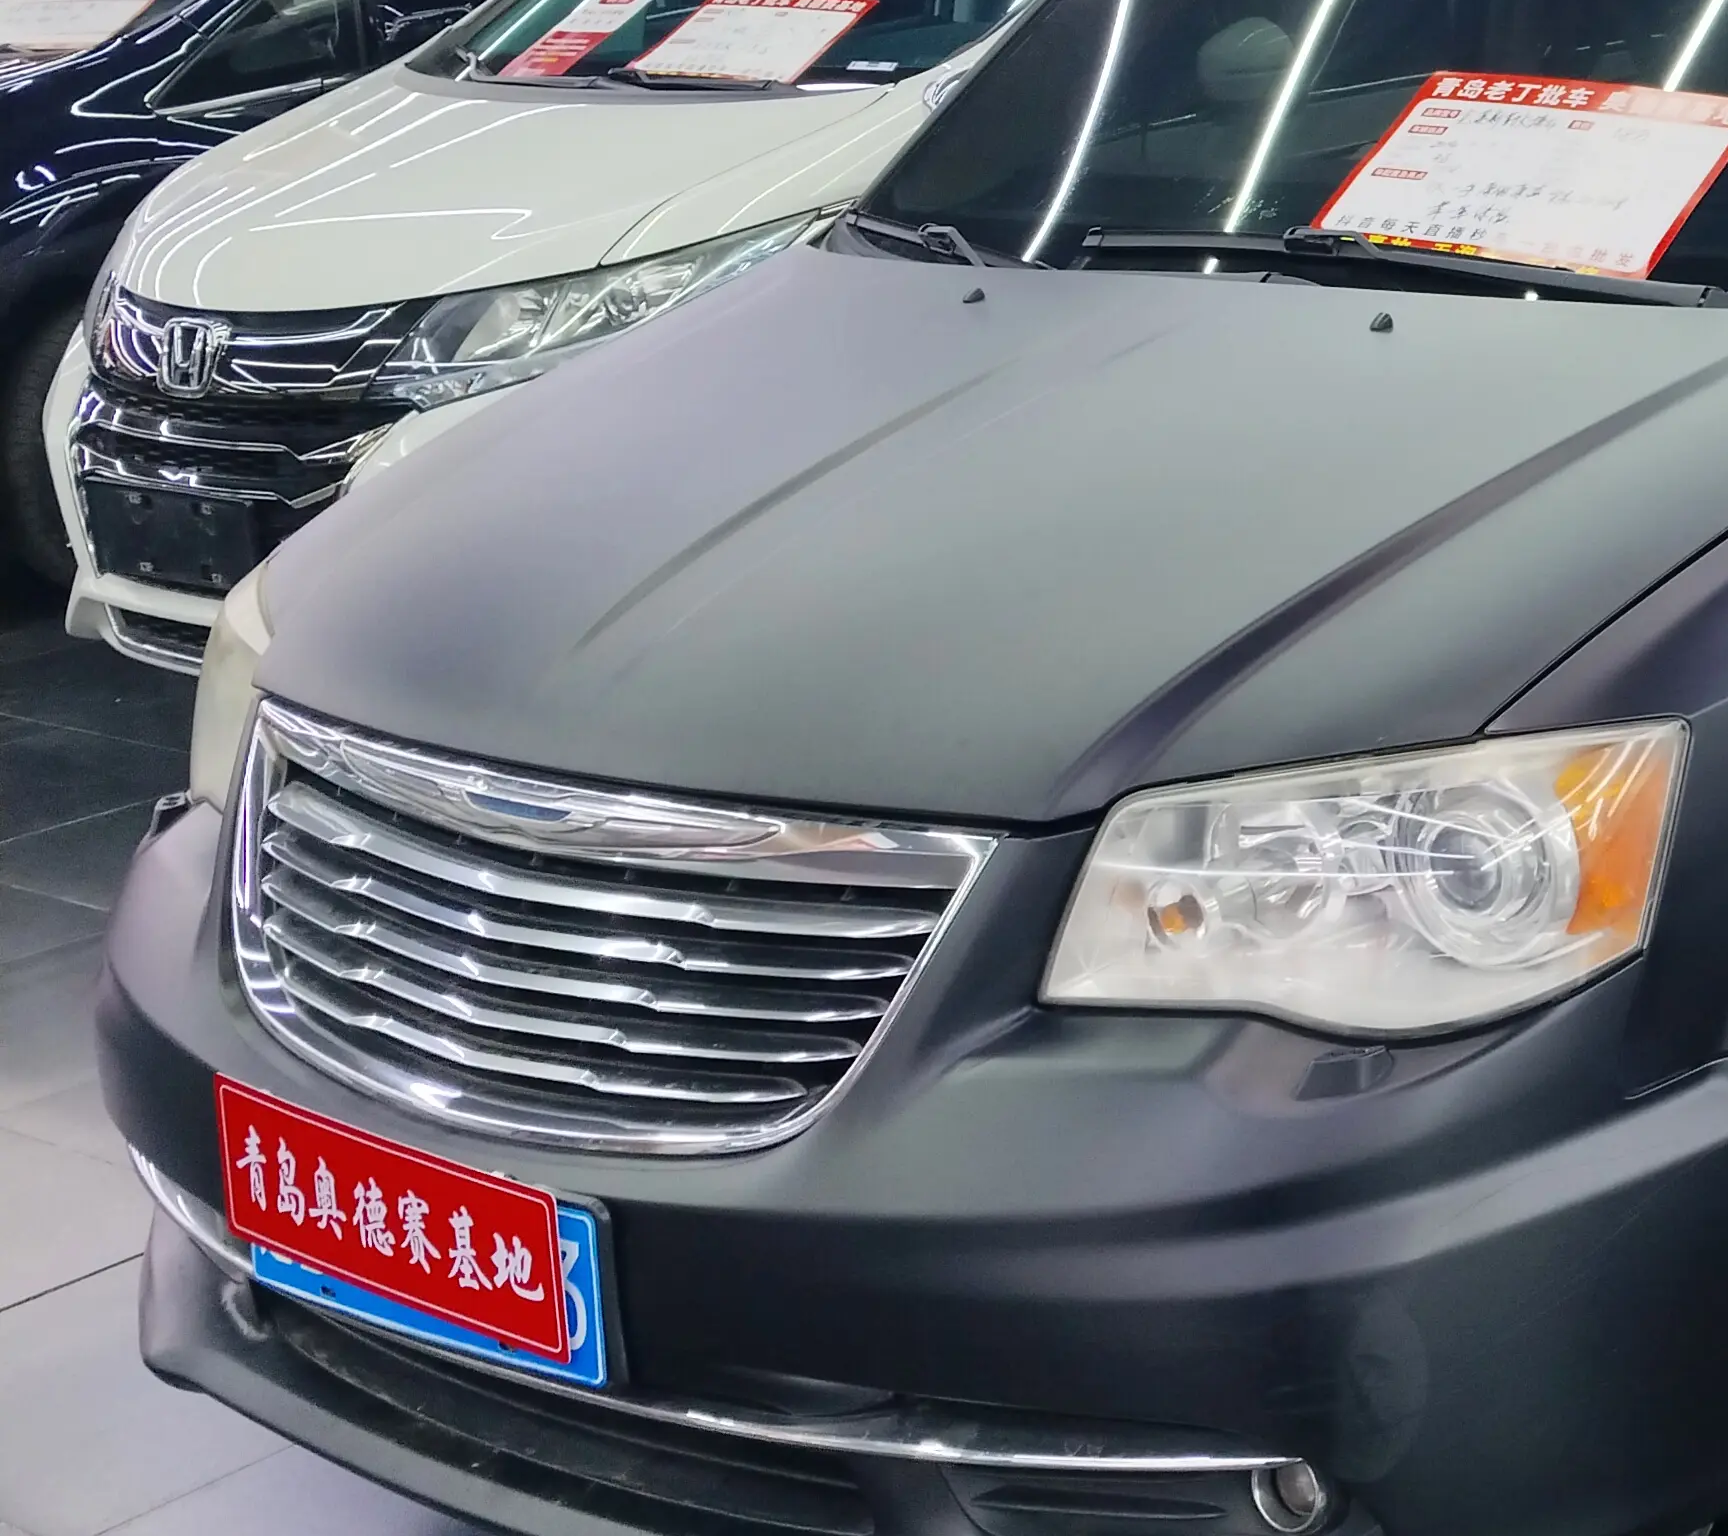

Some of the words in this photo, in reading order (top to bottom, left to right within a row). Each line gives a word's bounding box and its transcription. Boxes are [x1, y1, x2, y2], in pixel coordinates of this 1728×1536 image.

[1432, 76, 1595, 109] 青岛老丁批车
[236, 1125, 545, 1301] 青岛奥德赛基地
